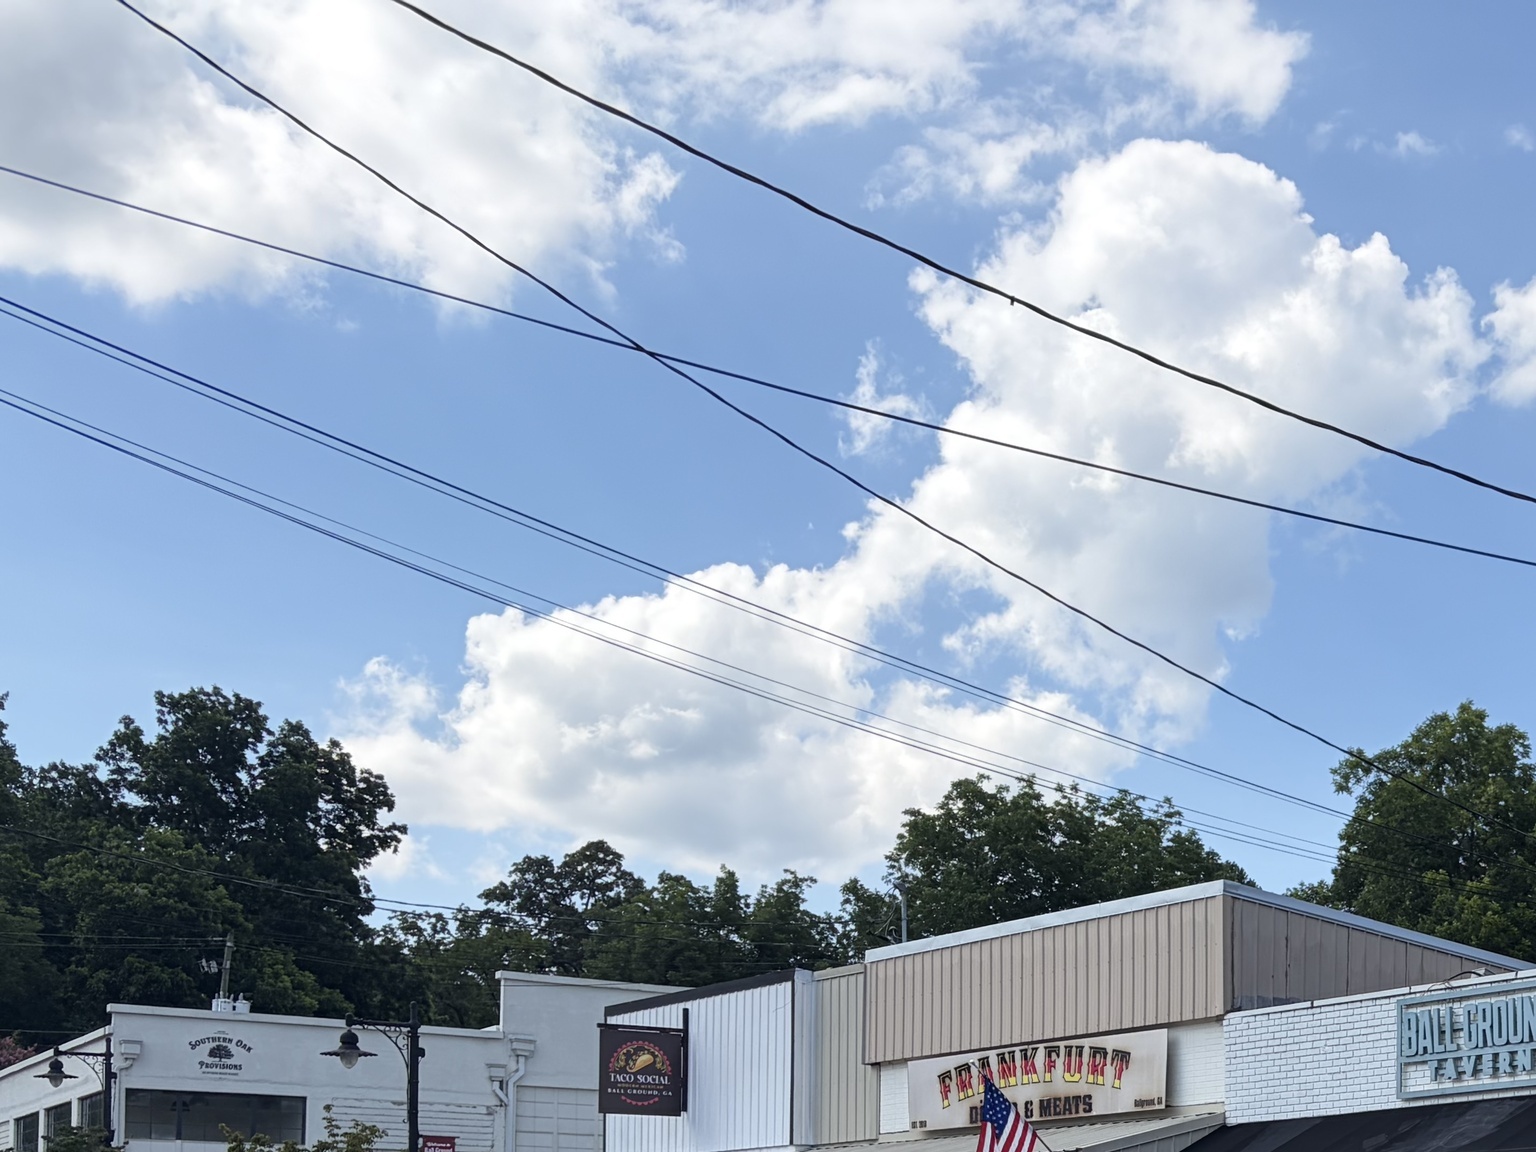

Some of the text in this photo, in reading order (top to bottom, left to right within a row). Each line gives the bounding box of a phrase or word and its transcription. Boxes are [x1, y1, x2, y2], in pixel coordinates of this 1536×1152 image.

[1402, 1006, 1458, 1057] BALL
[188, 1036, 253, 1053] SOUTHERN OAK
[198, 1060, 243, 1071] PROVISIONS
[936, 1045, 1132, 1110] FRANKFURT
[1428, 1049, 1533, 1082] TAVERN
[609, 1073, 671, 1085] TACO SOCIAL
[1039, 1094, 1094, 1119] MEATS
